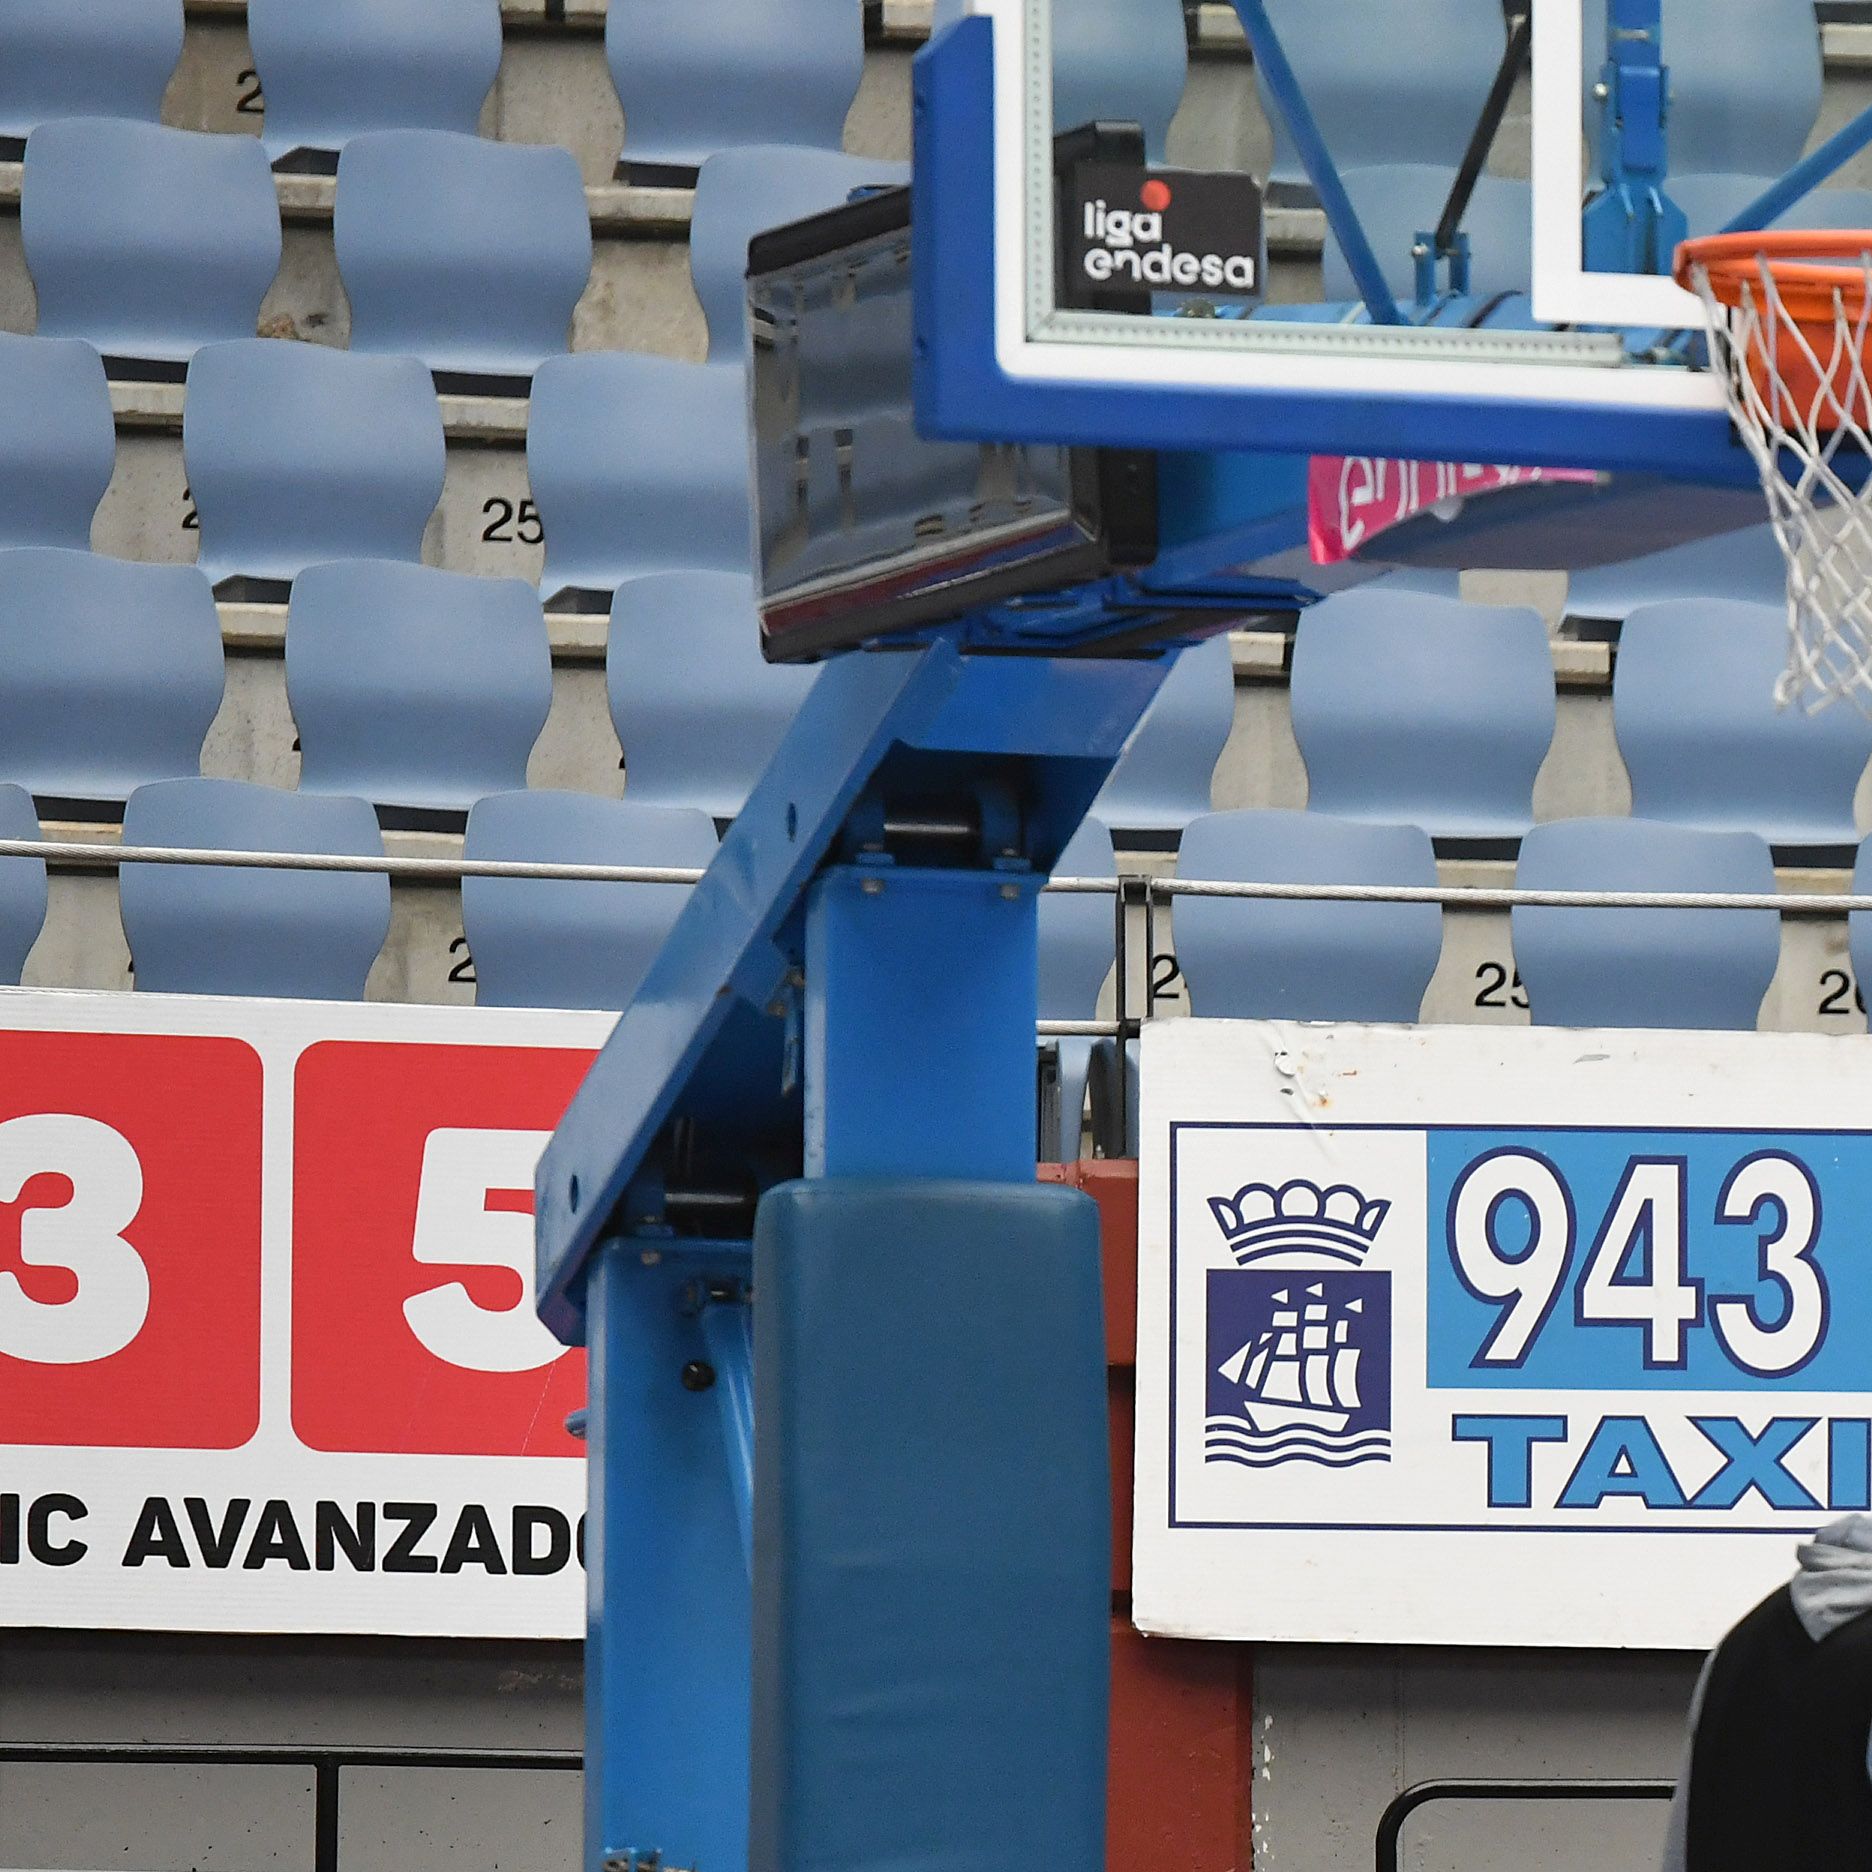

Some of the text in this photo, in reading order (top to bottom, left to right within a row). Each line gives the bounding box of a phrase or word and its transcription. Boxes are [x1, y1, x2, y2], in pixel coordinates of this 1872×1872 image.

[1083, 198, 1163, 248] liga
[1083, 243, 1255, 290] endesa
[481, 497, 545, 545] 25
[1151, 953, 1187, 999] 2
[1445, 1144, 1832, 1381] 943
[1450, 1413, 1872, 1513] TAXI
[121, 1496, 586, 1576] AVANZAD
